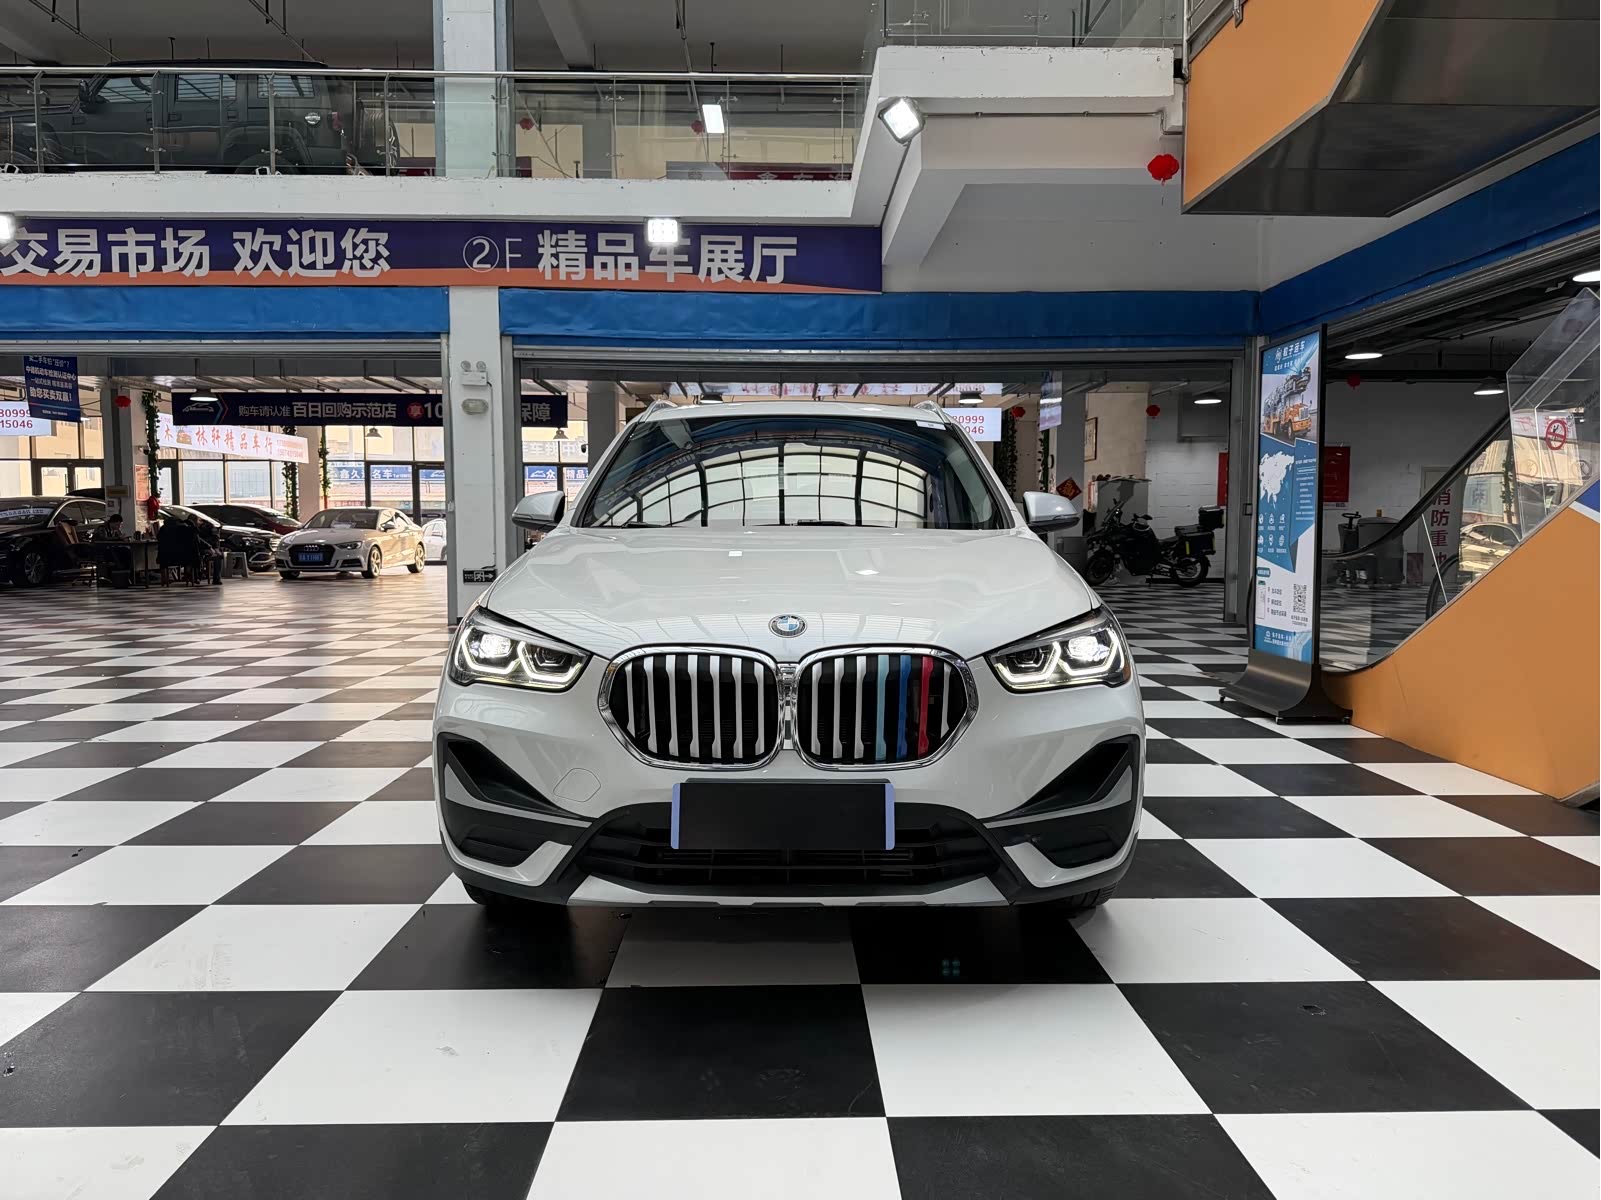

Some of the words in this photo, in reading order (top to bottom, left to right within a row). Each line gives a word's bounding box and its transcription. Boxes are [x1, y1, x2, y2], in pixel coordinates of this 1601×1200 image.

[0, 227, 210, 278] 交易市场
[232, 228, 391, 278] 欢迎您
[537, 229, 798, 285] 精品车展厅
[238, 405, 291, 417] 购车请认准
[292, 402, 397, 419] 百日回购示范店
[521, 402, 552, 422] 保障
